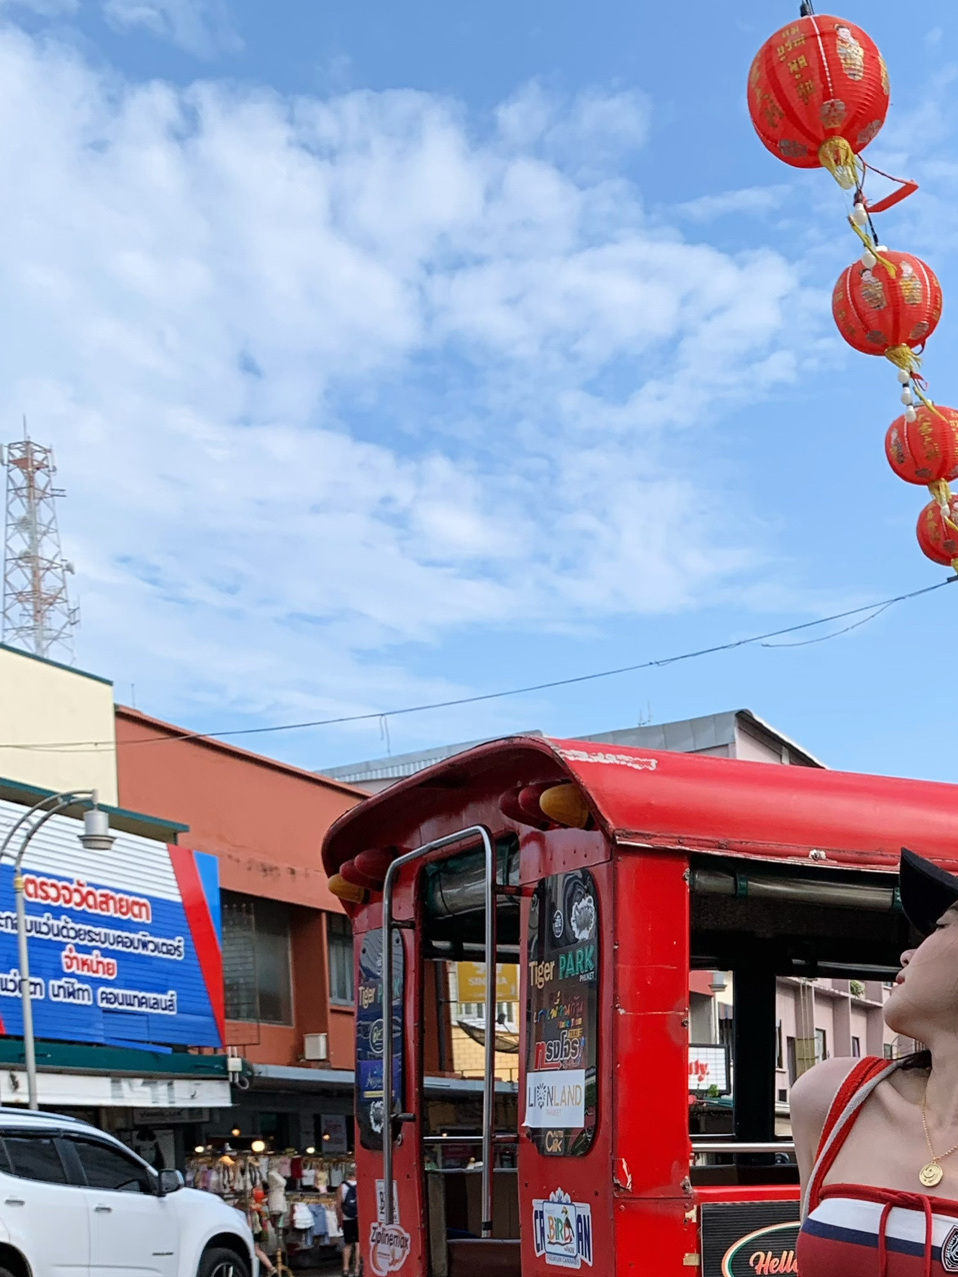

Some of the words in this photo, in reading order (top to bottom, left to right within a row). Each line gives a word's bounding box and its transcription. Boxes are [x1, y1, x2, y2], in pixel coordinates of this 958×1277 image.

[24, 877, 151, 922] ตรวจวัดสายตา
[63, 946, 117, 977] จำหน่าย
[529, 960, 555, 989] Tiger
[559, 945, 595, 980] PARK
[52, 979, 91, 1003] นาฬิกา
[100, 989, 177, 1013] คอนแทคเลนส์
[358, 986, 376, 1009] Tiger
